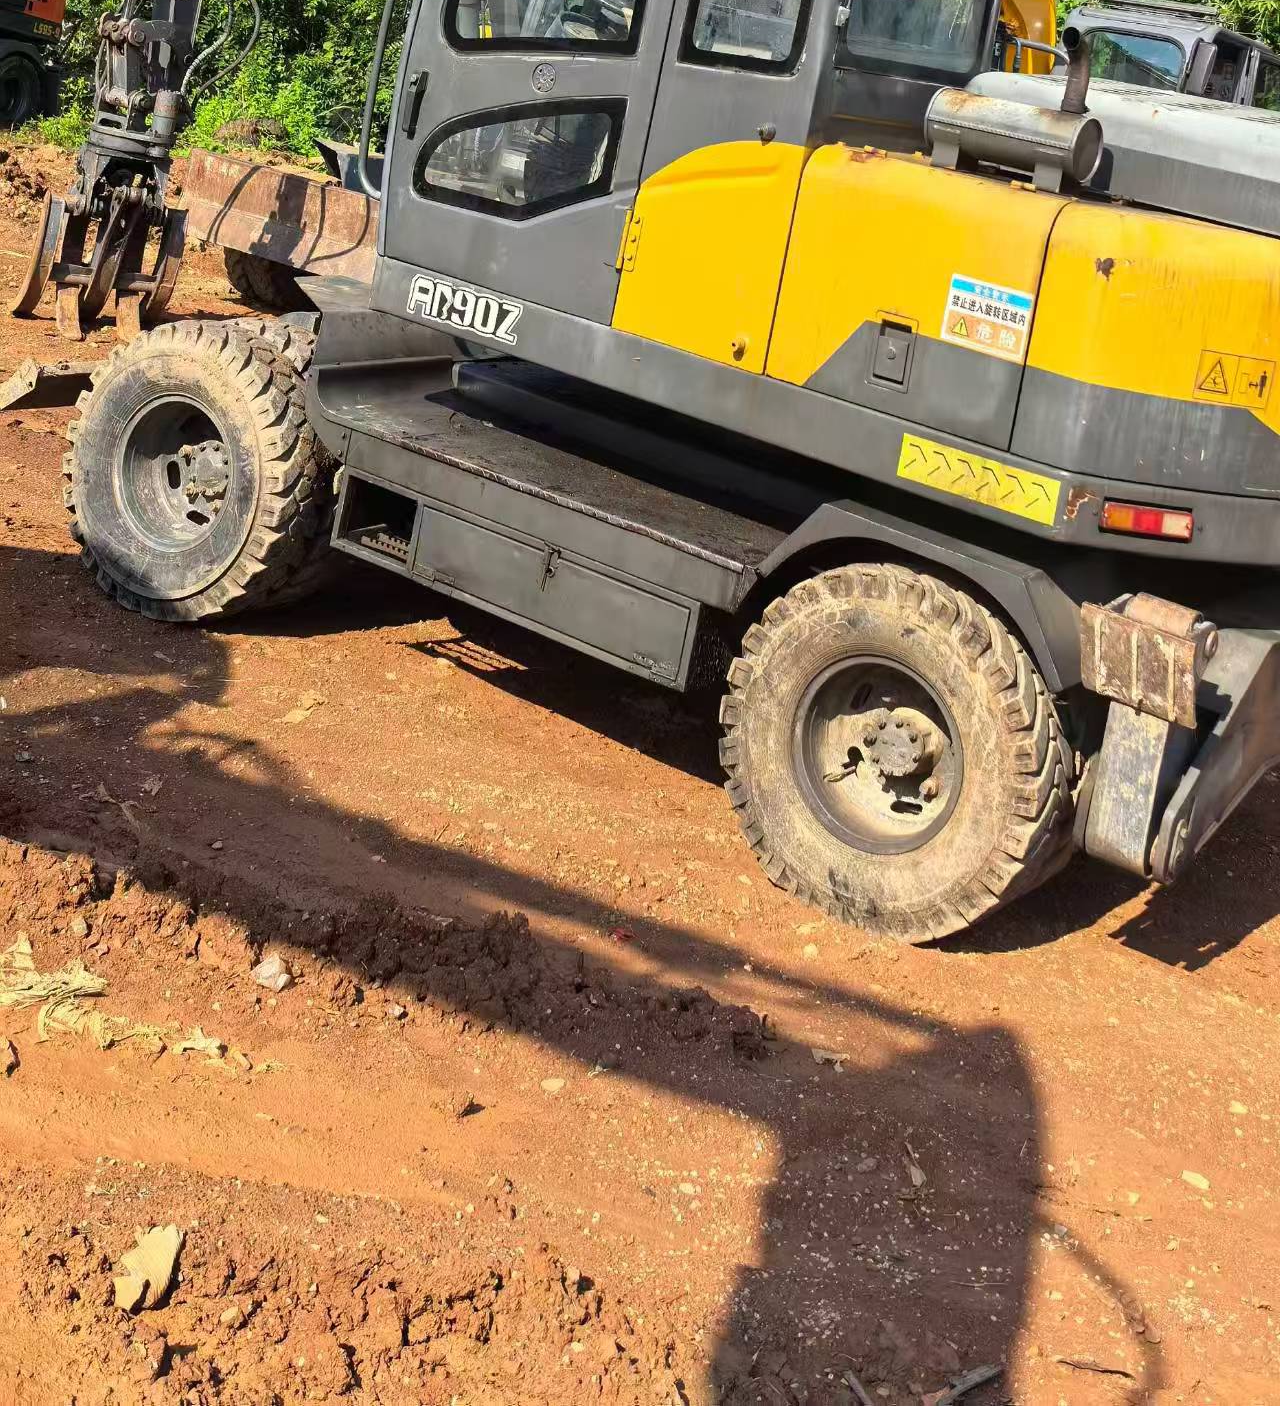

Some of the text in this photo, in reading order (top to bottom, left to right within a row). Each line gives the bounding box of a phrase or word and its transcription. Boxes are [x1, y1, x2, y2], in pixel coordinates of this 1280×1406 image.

[950, 294, 1027, 327] 禁止进入旋转区域内
